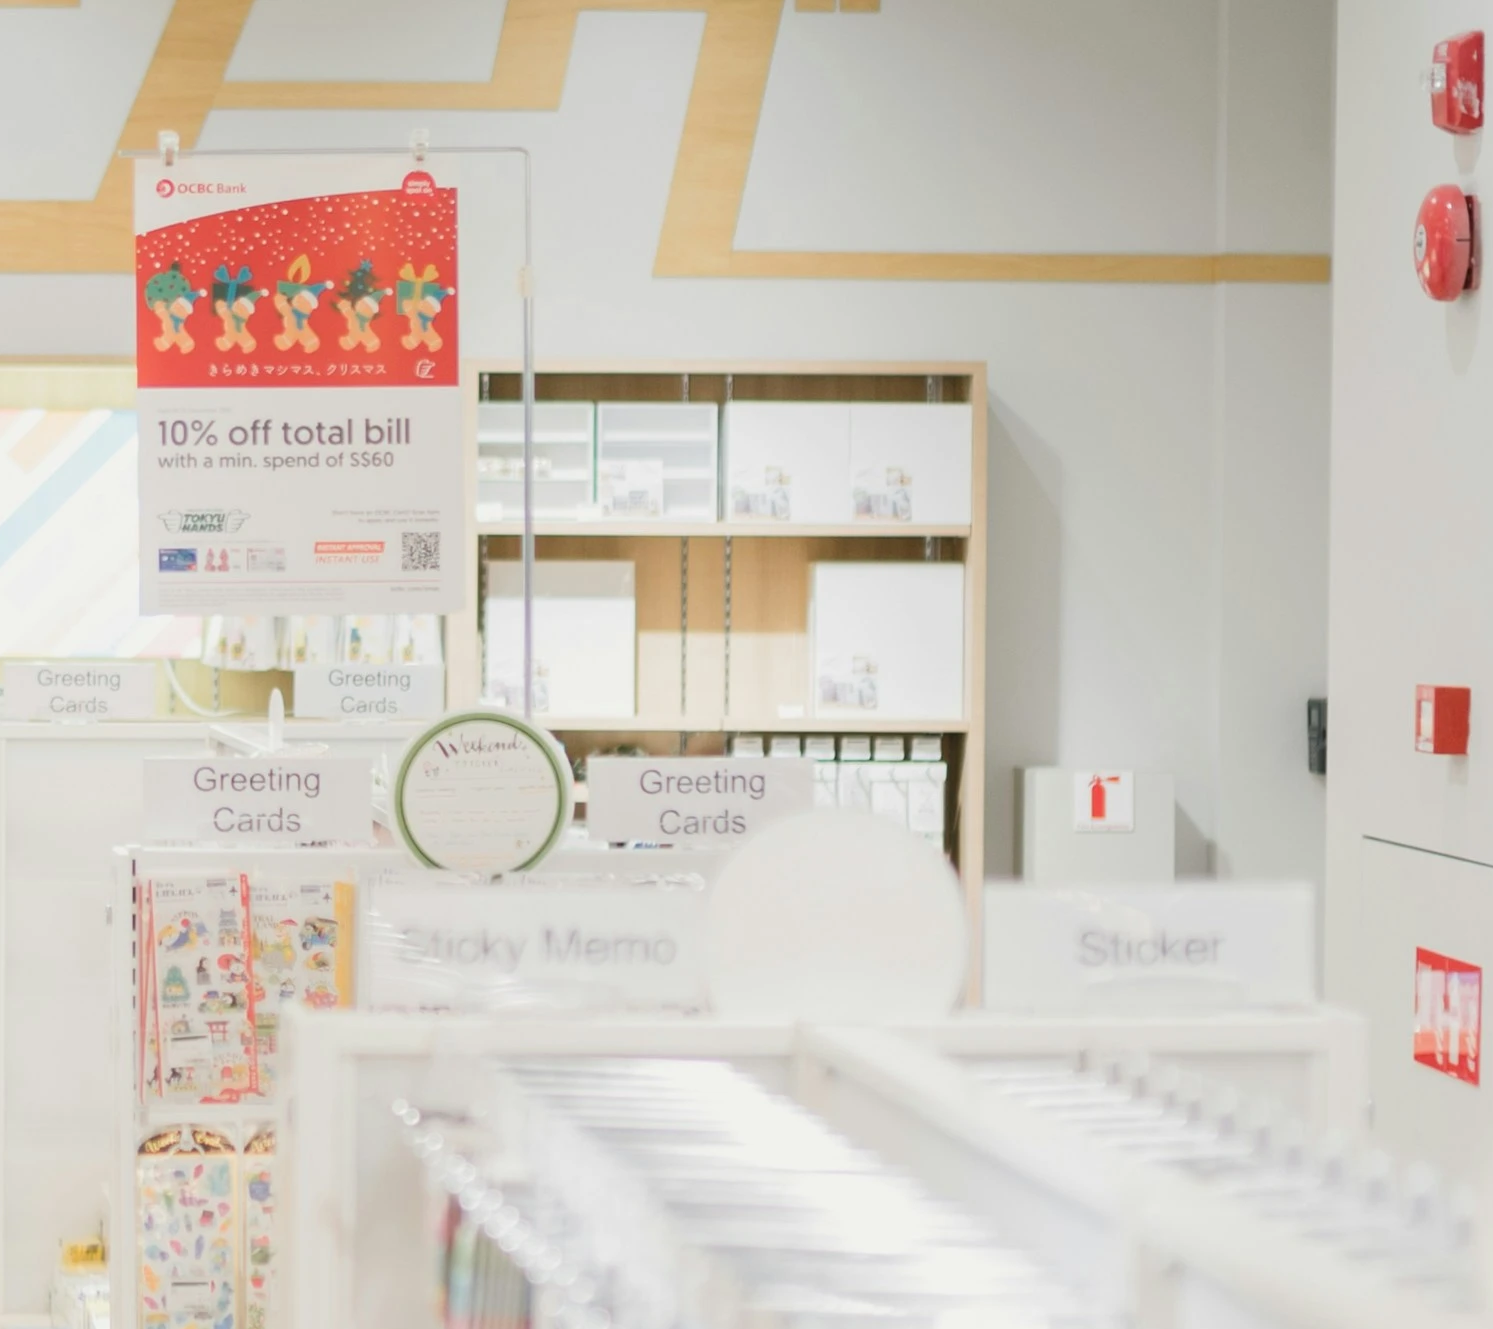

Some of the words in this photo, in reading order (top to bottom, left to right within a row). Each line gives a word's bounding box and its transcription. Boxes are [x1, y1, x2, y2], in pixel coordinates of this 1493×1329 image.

[177, 183, 214, 194] OCBC
[216, 183, 247, 194] Bank
[157, 420, 218, 446] 10%
[228, 419, 272, 446] off
[282, 418, 353, 445] total
[364, 418, 411, 445] bill
[157, 452, 198, 468] with
[203, 456, 213, 468] a
[218, 453, 258, 468] min.
[262, 452, 321, 471] spend
[324, 452, 344, 468] of
[181, 523, 224, 533] HANDS
[183, 513, 226, 523] TOKYU
[36, 668, 122, 691] Greeting
[327, 668, 412, 691] Greeting
[49, 695, 108, 715] Cards
[339, 695, 398, 715] Cards
[193, 764, 321, 799] Greeting
[639, 768, 767, 801] Greeting
[212, 807, 303, 835] Cards
[659, 809, 748, 837] Cards
[398, 925, 529, 974] Sticky
[541, 923, 679, 967] Memo
[1077, 926, 1226, 968] Sticker
